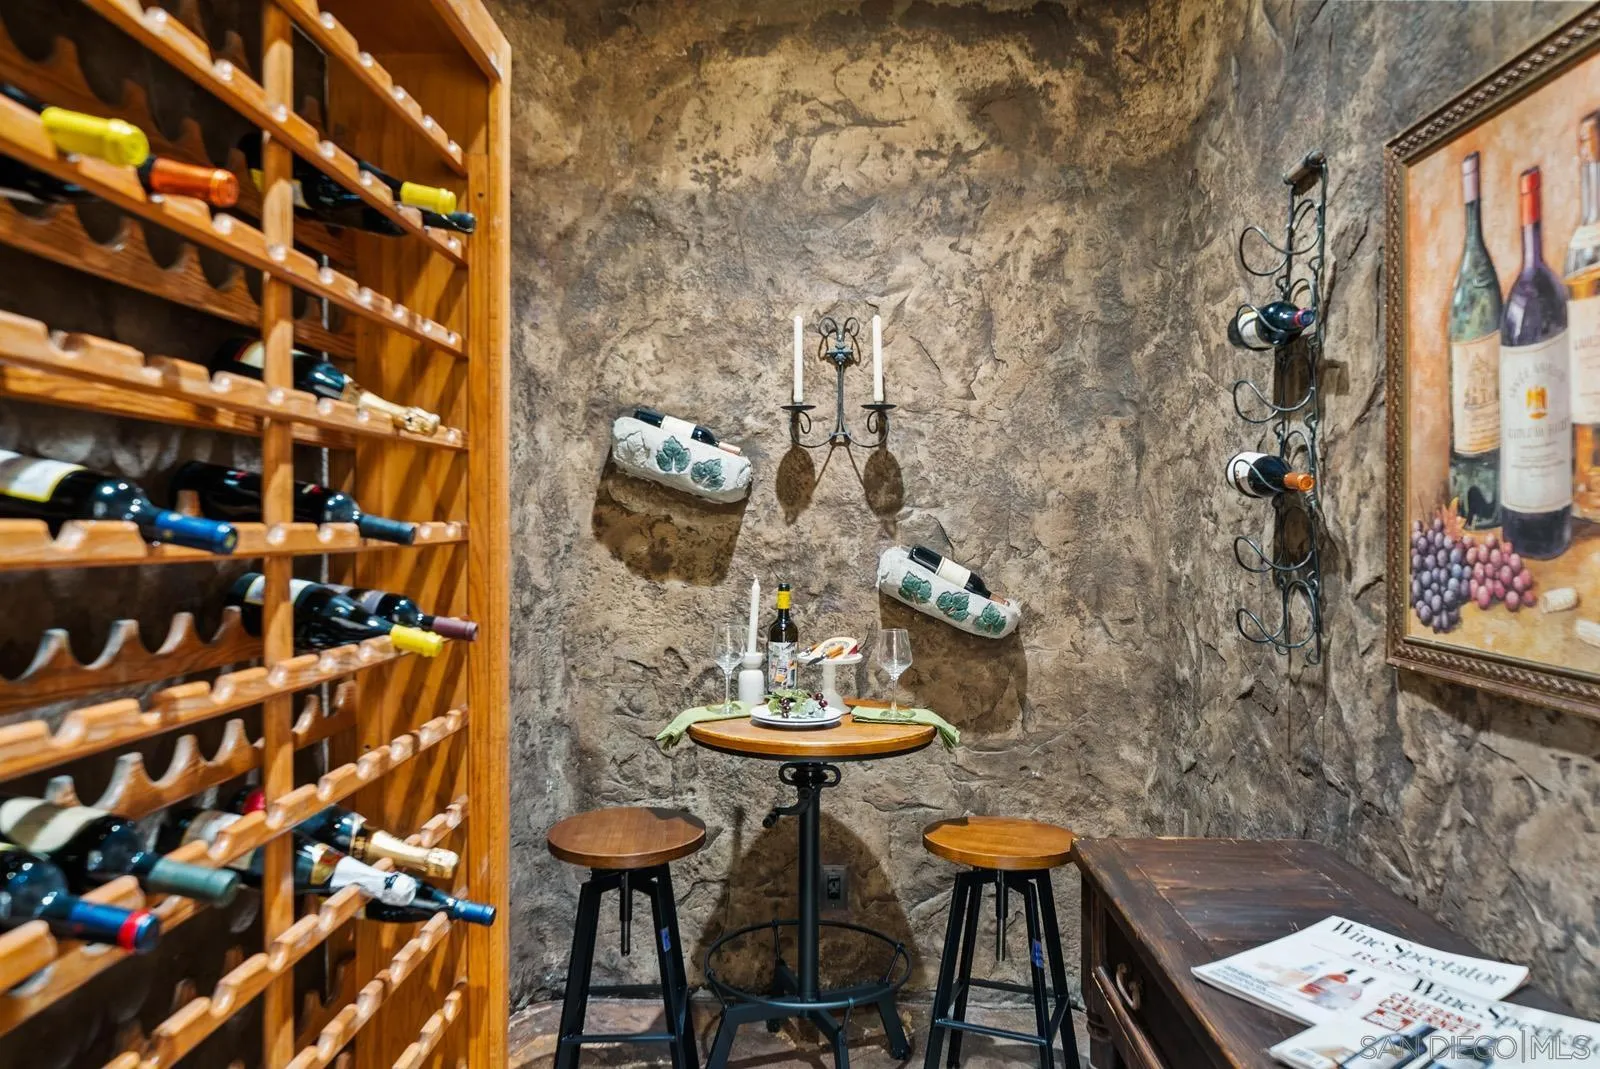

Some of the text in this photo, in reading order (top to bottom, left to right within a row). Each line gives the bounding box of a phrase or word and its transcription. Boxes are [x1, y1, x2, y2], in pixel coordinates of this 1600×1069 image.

[1332, 920, 1507, 985] Wine Spectator
[1411, 977, 1600, 1053] Wine Spectat
